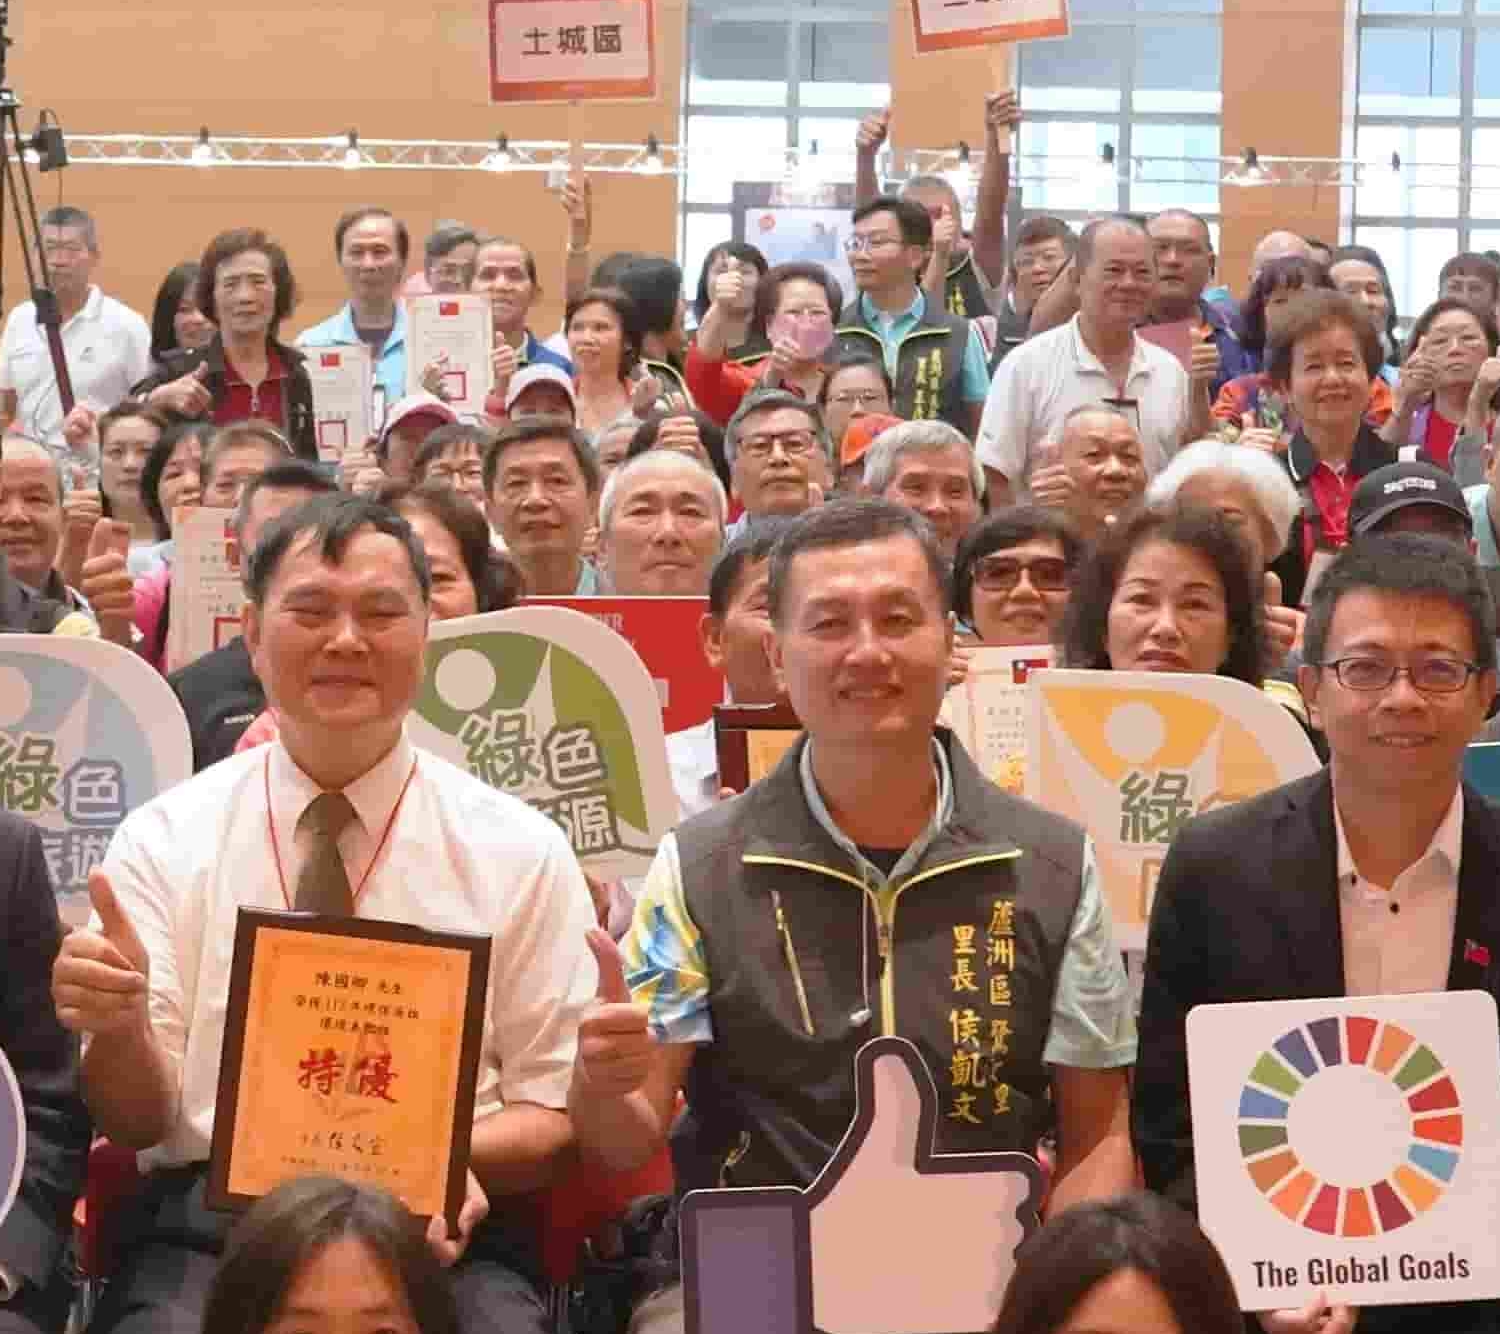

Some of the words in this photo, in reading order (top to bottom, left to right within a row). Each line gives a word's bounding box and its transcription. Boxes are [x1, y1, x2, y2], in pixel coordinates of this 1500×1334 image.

[521, 24, 622, 57] 土城區
[460, 711, 607, 790] 綠色
[950, 925, 980, 991] 里長
[985, 900, 1017, 1007] 蘆洲區
[298, 1047, 400, 1104] 特優
[1252, 1261, 1298, 1288] The
[1307, 1255, 1390, 1286] Global
[1399, 1251, 1471, 1281] Goals
